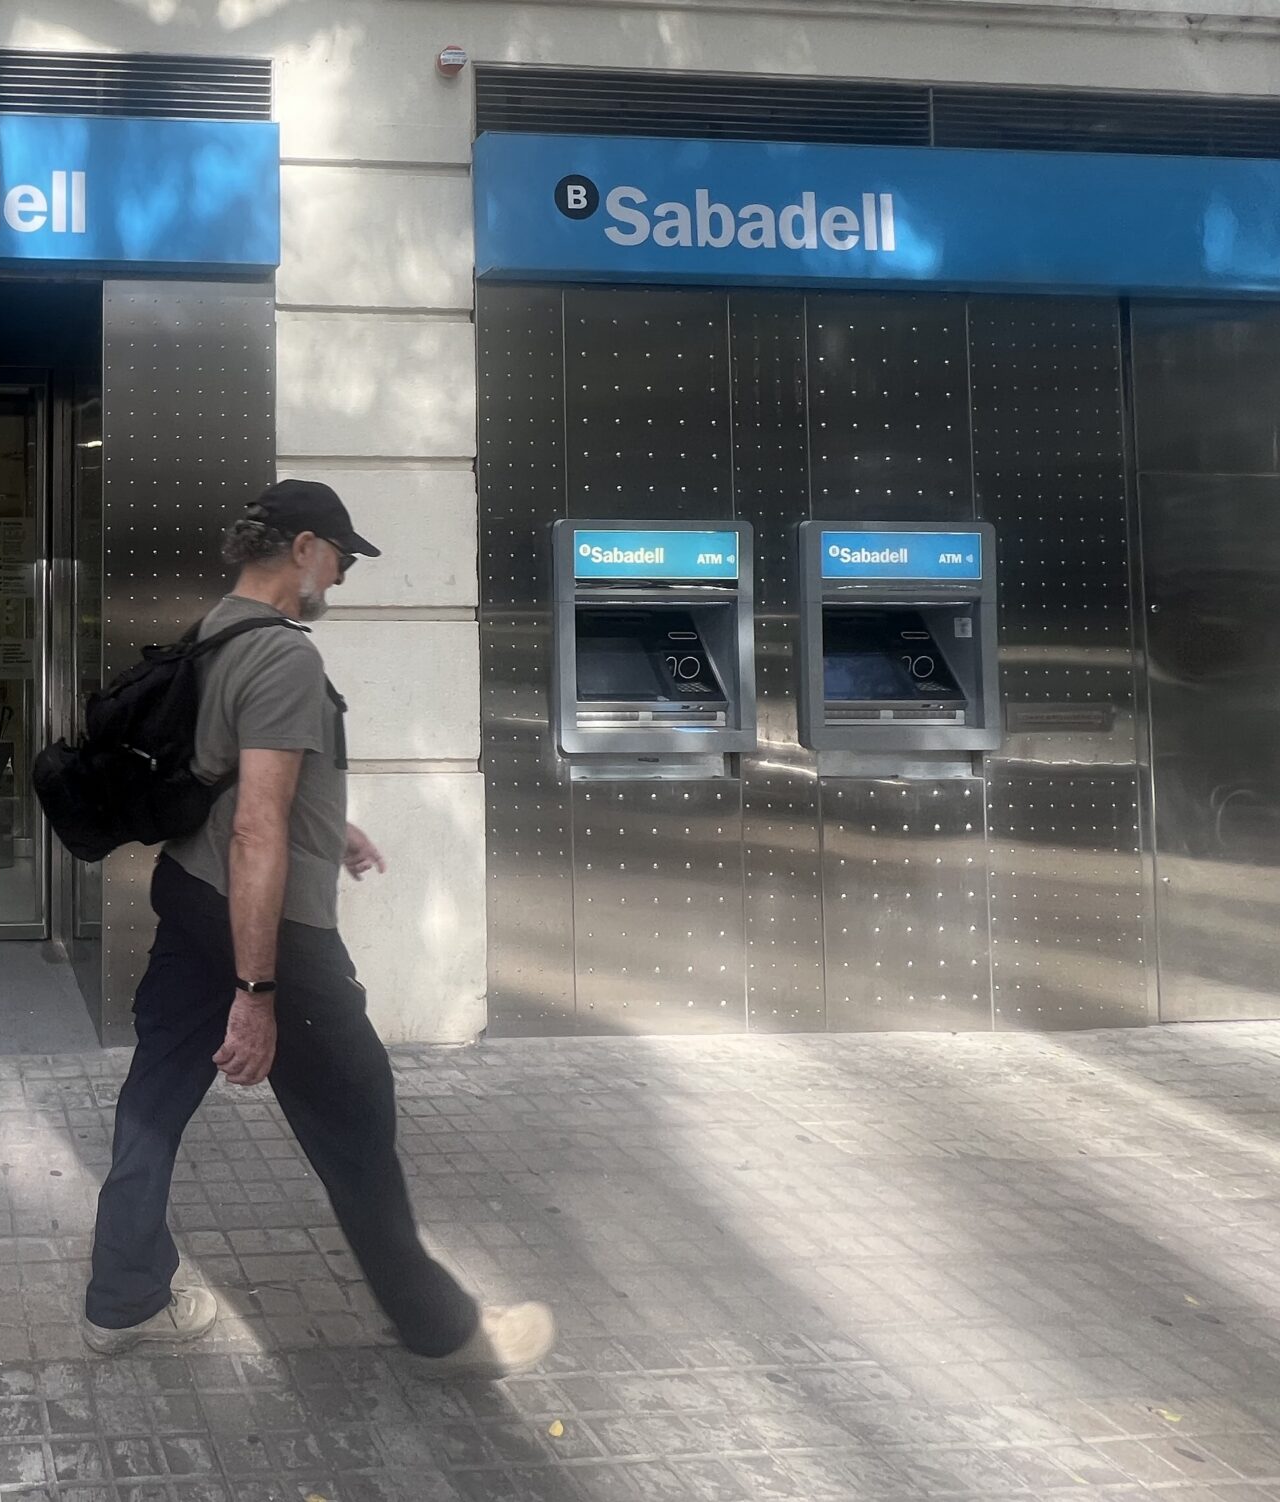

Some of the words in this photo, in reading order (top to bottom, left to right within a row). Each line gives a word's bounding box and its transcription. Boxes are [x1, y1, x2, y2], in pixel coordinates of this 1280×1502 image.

[603, 185, 896, 252] Sabadell
[590, 546, 665, 564] Sabadell
[696, 553, 723, 565] ATM
[839, 547, 908, 564] Sabadell
[938, 553, 962, 564] ATM
